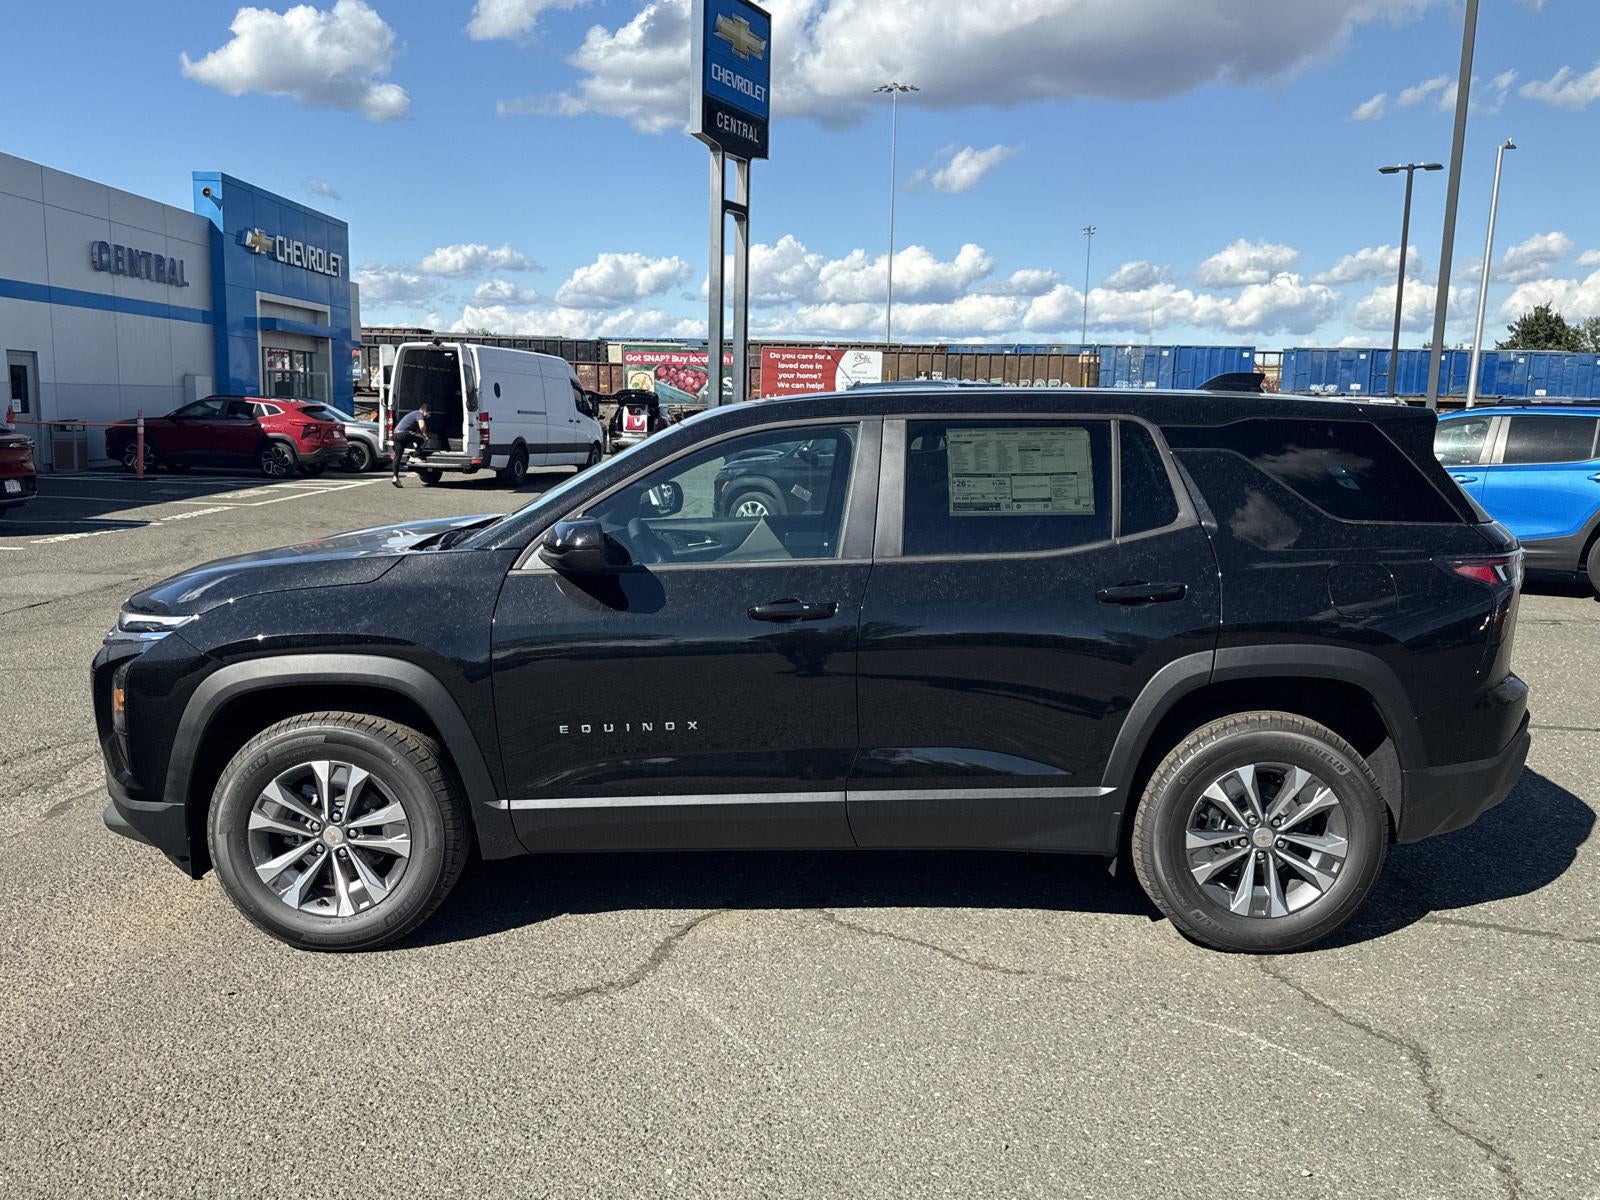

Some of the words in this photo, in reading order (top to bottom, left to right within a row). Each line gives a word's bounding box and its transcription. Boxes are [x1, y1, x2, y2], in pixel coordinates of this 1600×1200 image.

[711, 63, 767, 103] CHEVROLET
[716, 111, 759, 144] CENTRAL
[275, 235, 343, 278] CHEVROLET
[91, 240, 190, 288] CENTRAL
[625, 354, 642, 362] Got
[643, 354, 670, 363] SNAP?
[671, 355, 688, 365] Buy
[781, 353, 796, 361] you
[814, 352, 826, 360] for
[815, 362, 823, 370] in
[796, 372, 822, 380] home?
[806, 382, 825, 391] help!
[559, 721, 698, 734] EQUINOX
